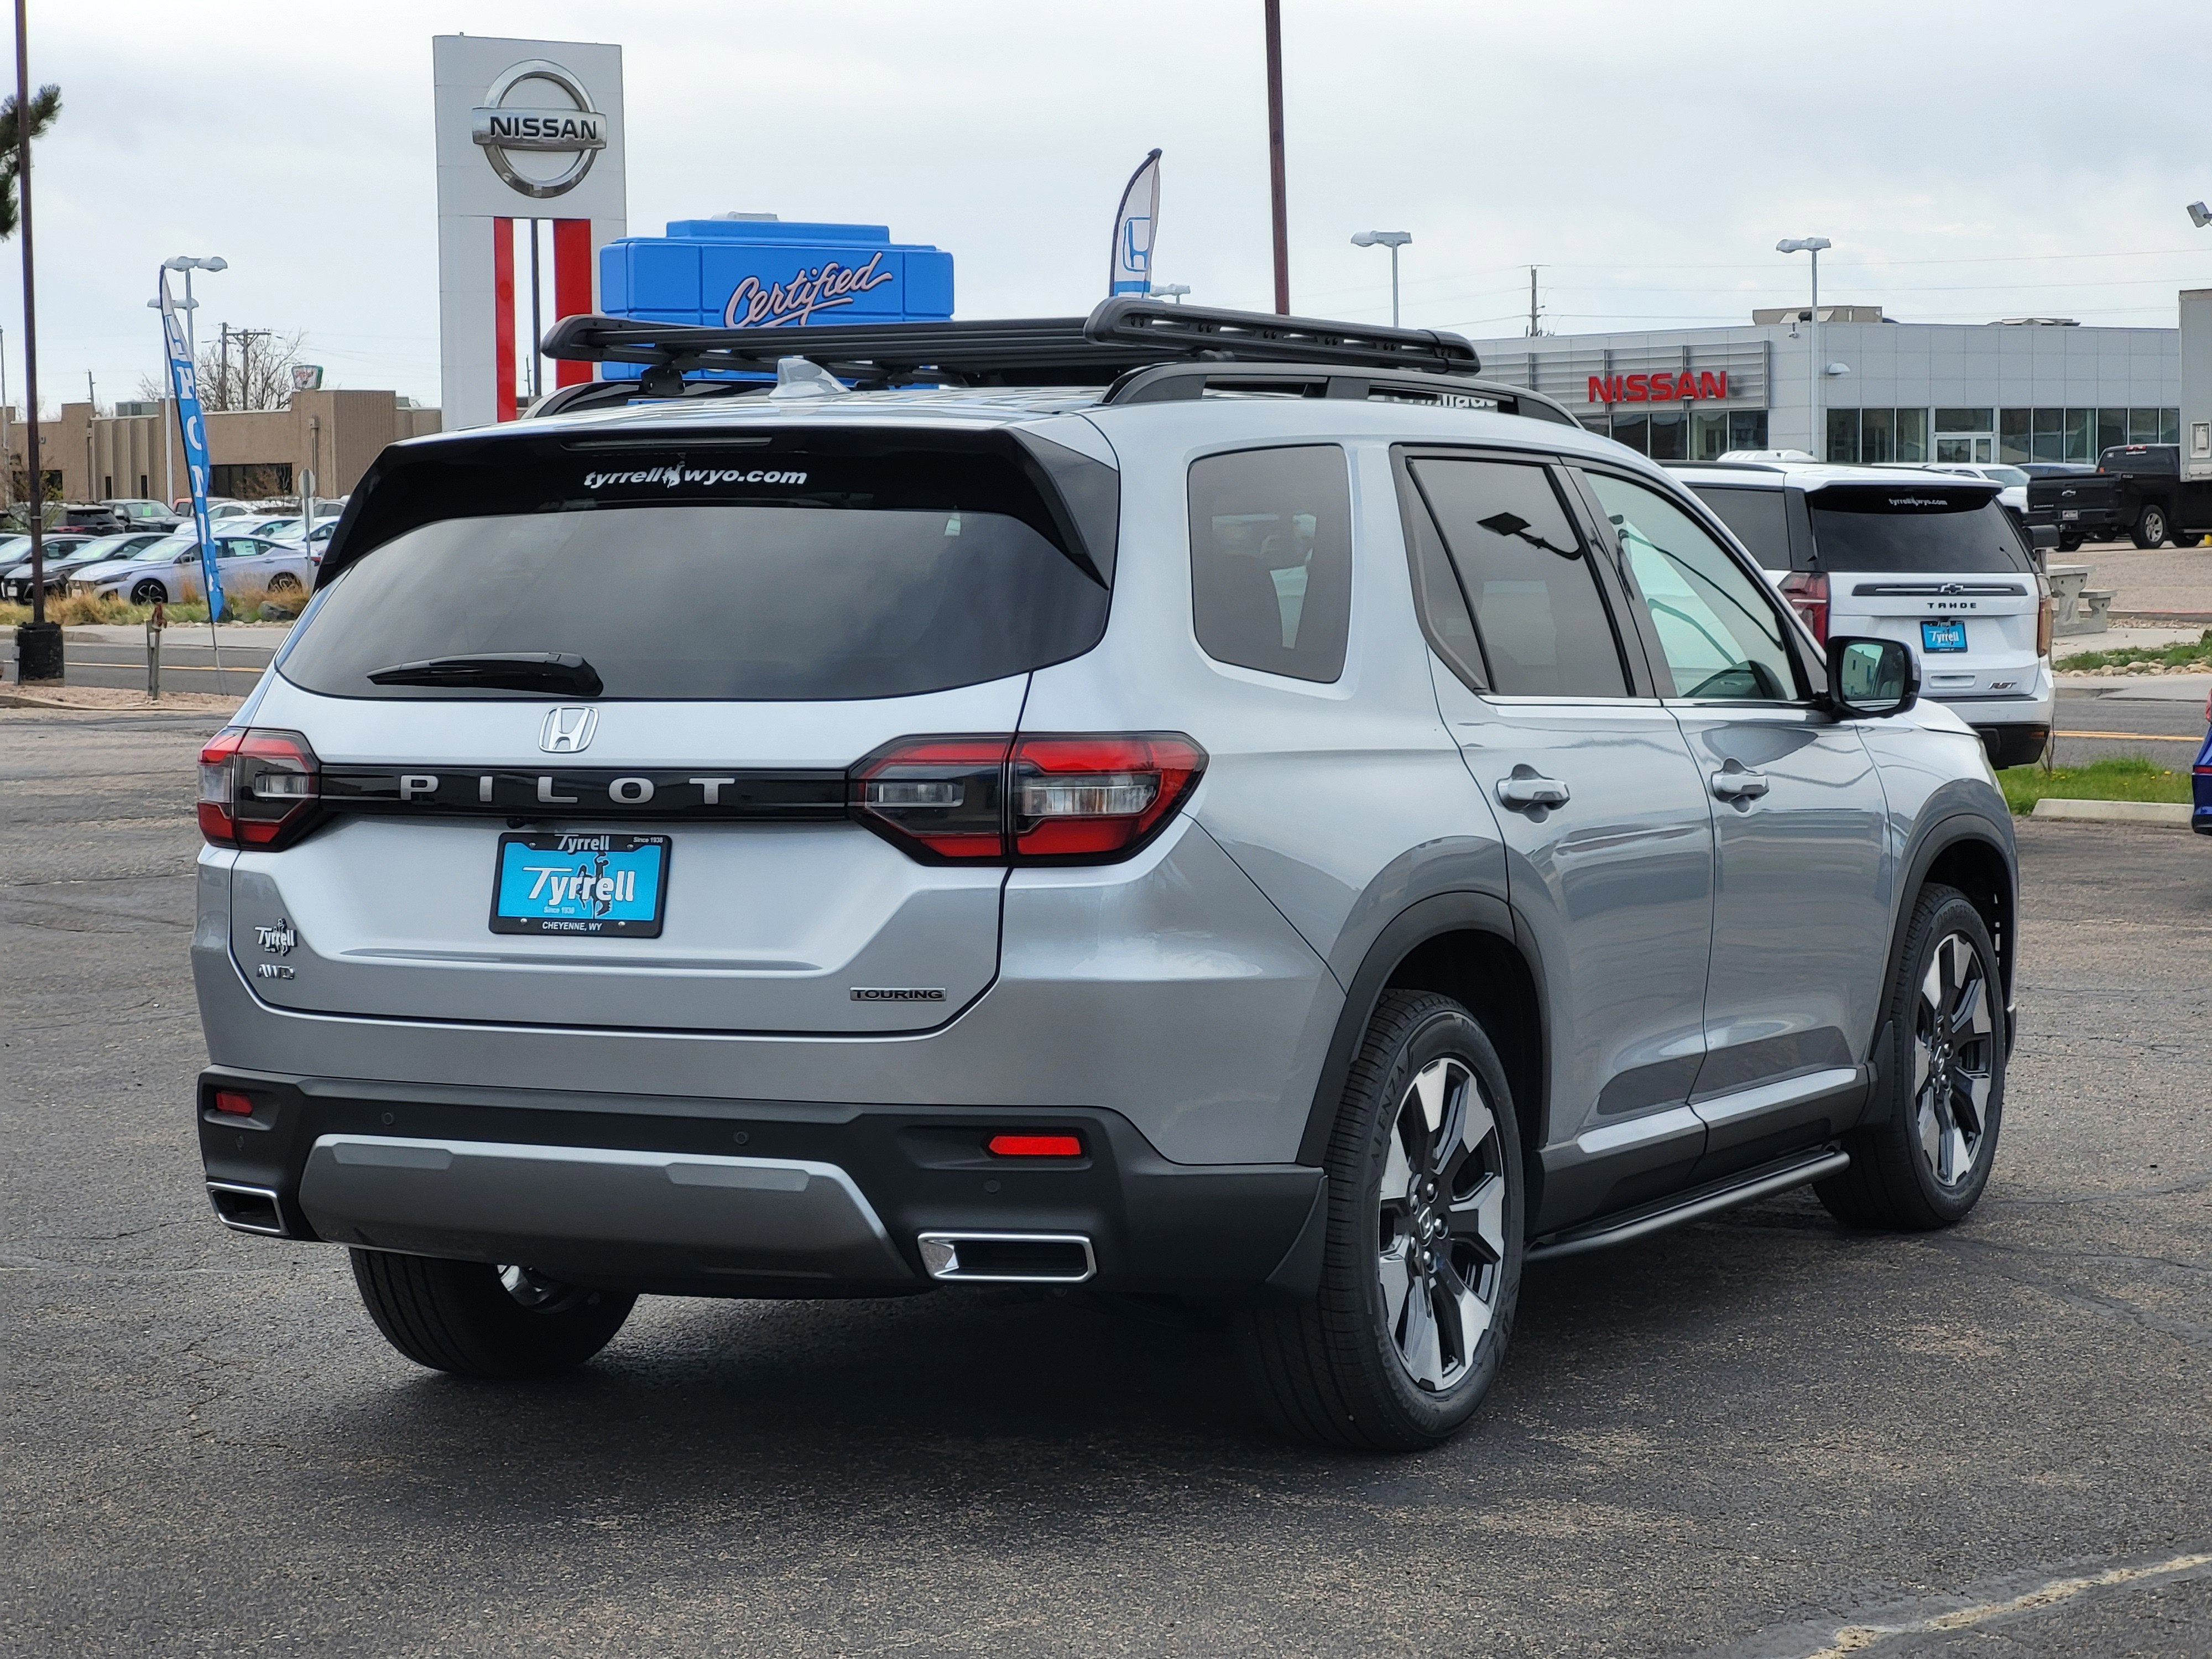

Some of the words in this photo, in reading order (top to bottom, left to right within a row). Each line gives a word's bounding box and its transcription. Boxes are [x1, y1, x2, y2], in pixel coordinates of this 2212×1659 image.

[490, 116, 596, 139] NISSAN
[724, 251, 893, 327] Certified
[1588, 371, 1727, 403] NISSAN
[400, 774, 735, 805] PILOT
[554, 834, 609, 853] Tyrrell
[523, 867, 635, 905] Tyrrell
[254, 926, 295, 948] Tyrrell
[542, 921, 586, 932] CHEYENNE,
[588, 922, 602, 931] WY
[853, 989, 942, 999] TOURING
